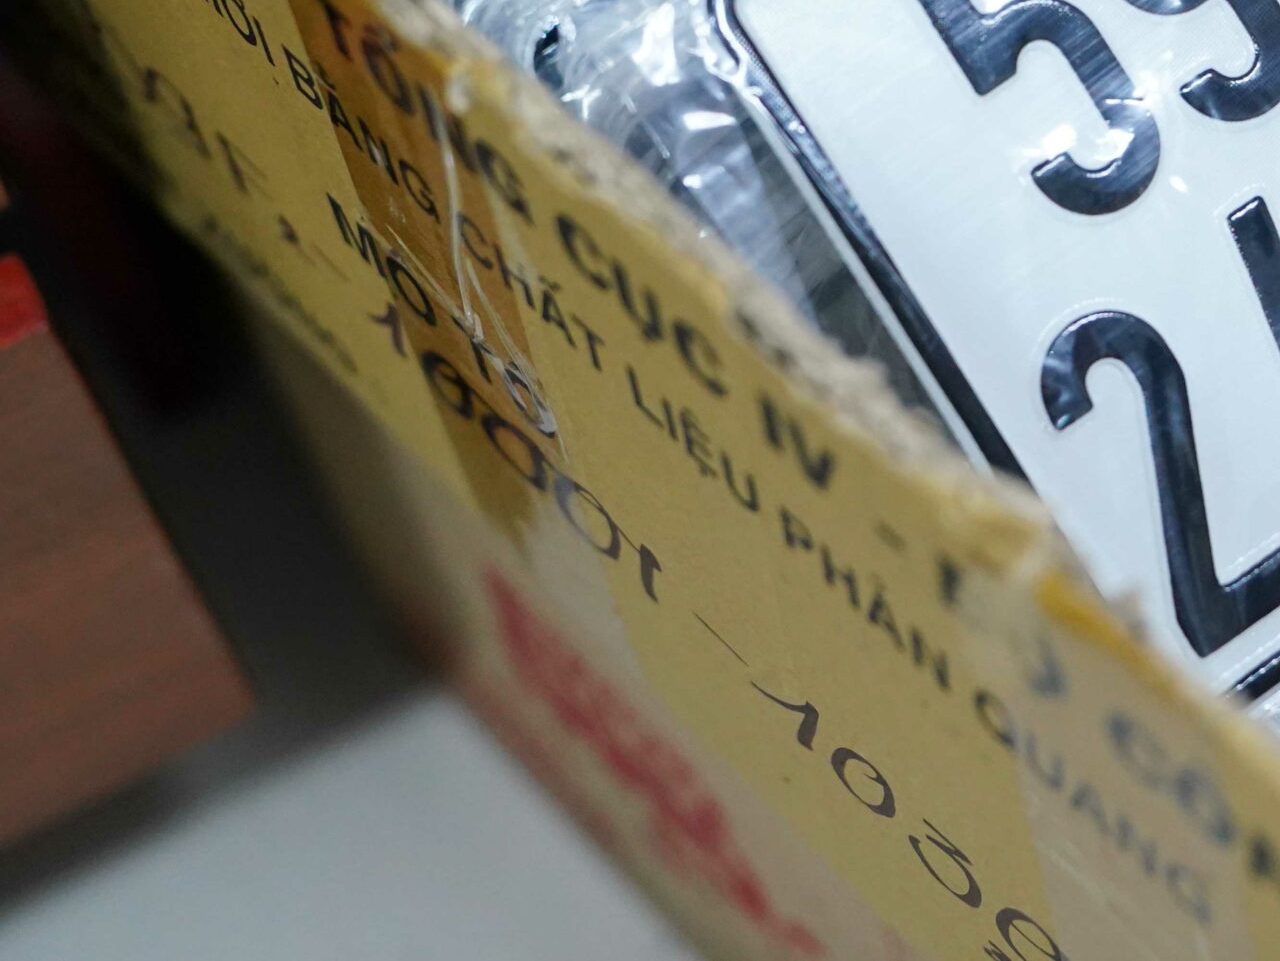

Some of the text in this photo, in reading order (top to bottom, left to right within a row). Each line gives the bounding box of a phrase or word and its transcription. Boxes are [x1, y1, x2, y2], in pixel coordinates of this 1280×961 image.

[282, 43, 440, 224] BẰNG
[456, 211, 604, 372] CHẤT
[625, 364, 760, 512] LIỆU
